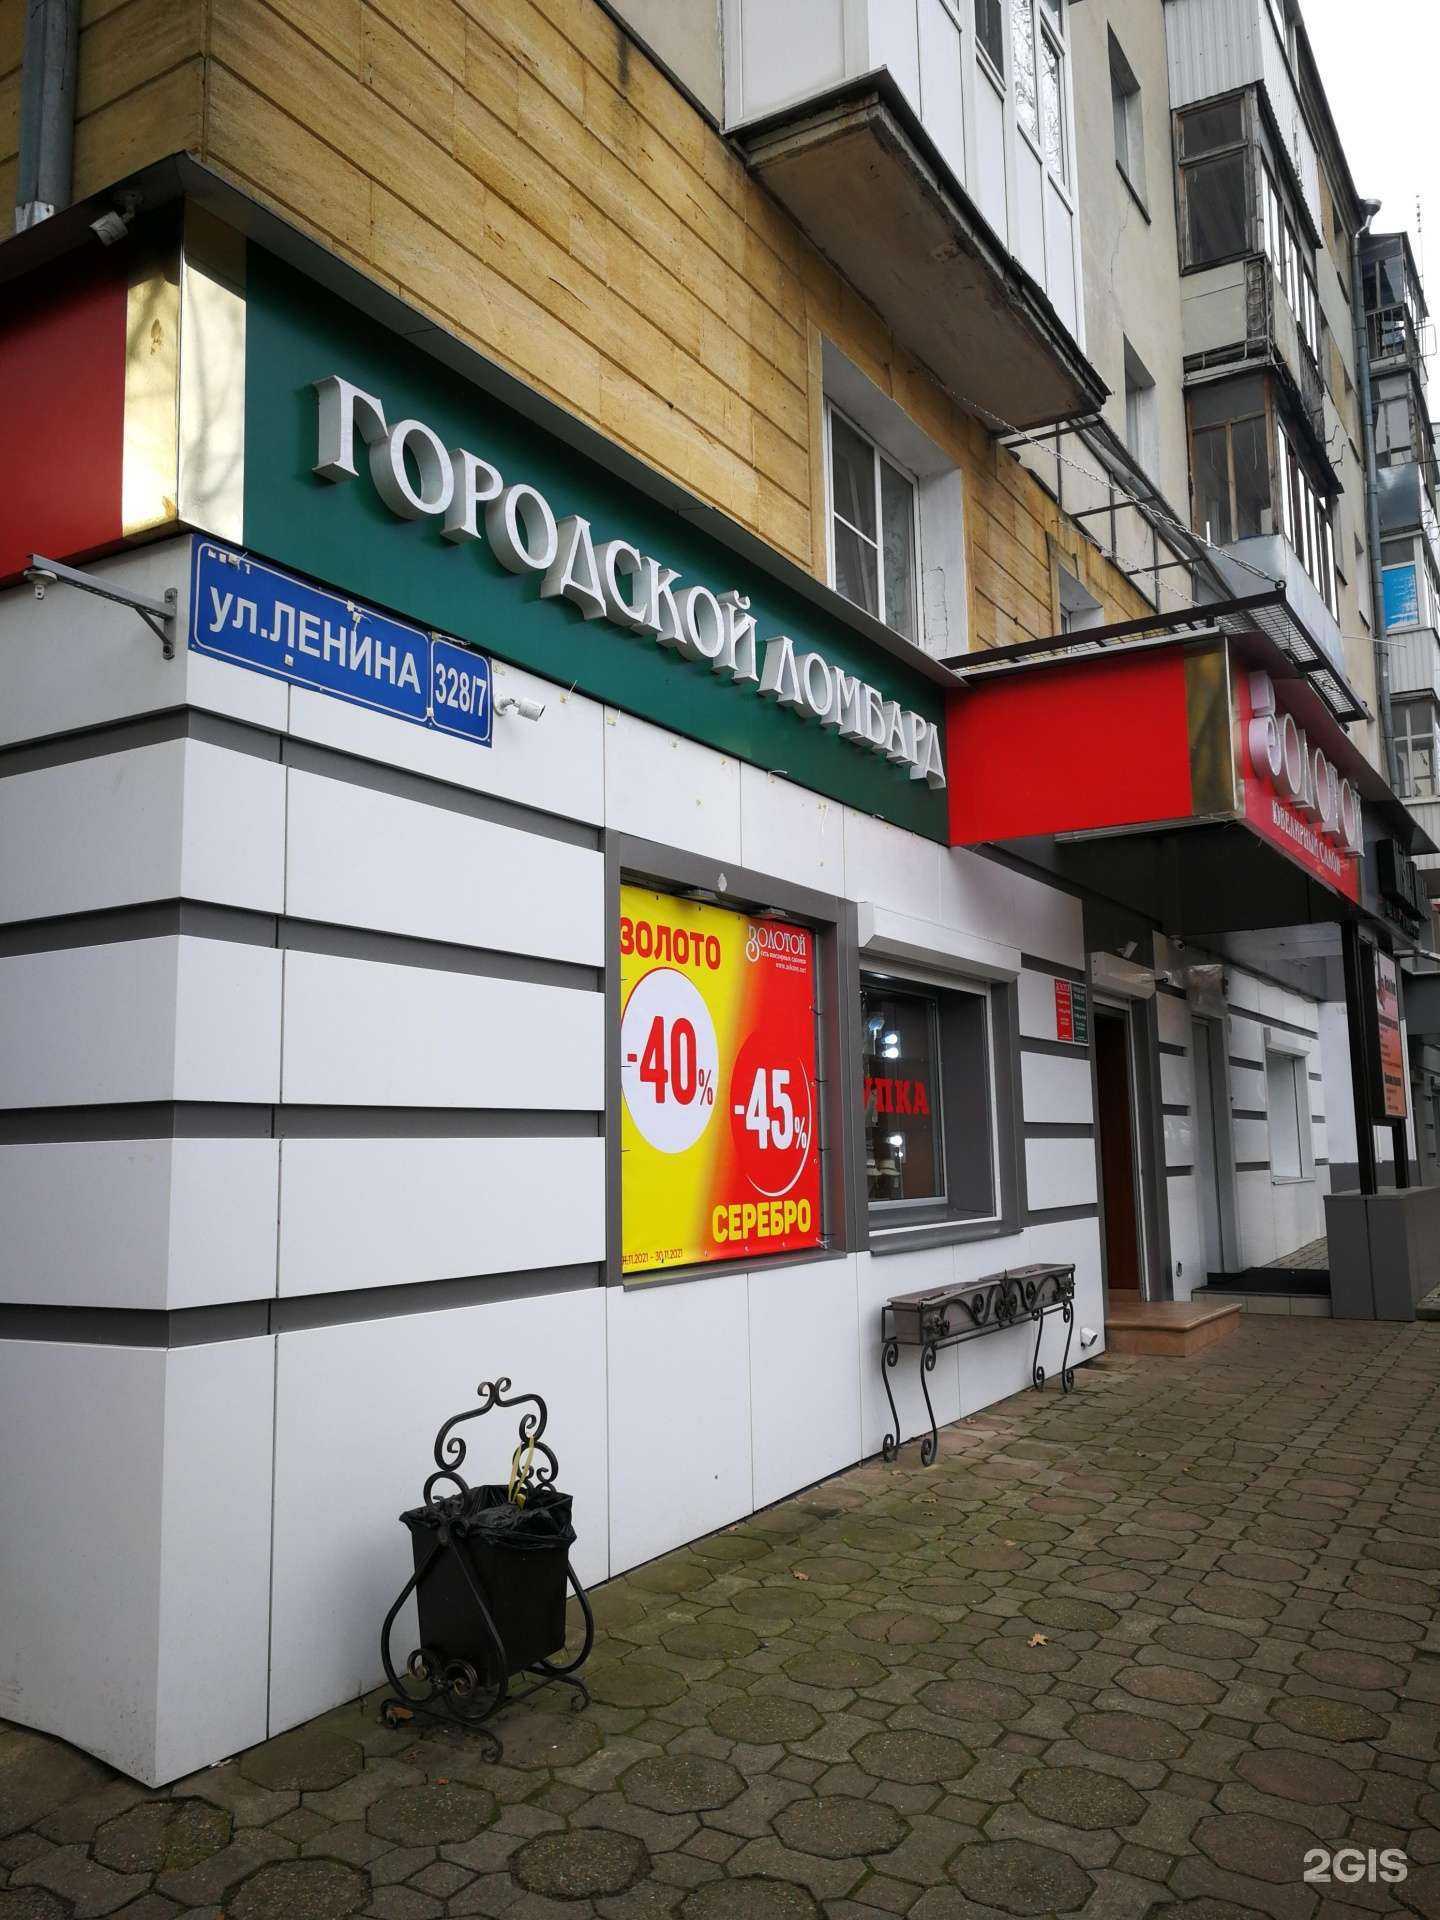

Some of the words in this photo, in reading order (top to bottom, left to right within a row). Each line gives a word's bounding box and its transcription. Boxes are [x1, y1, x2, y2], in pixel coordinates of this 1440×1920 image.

[312, 375, 759, 682] ГОРОДСКОЙ
[757, 635, 946, 790] ЛОМБАРД
[435, 663, 488, 717] 328/7
[620, 916, 721, 970] ЗОЛОТО
[745, 925, 806, 963] ЗОЛОТОЙ
[712, 1198, 811, 1243] СЕРЕБРО
